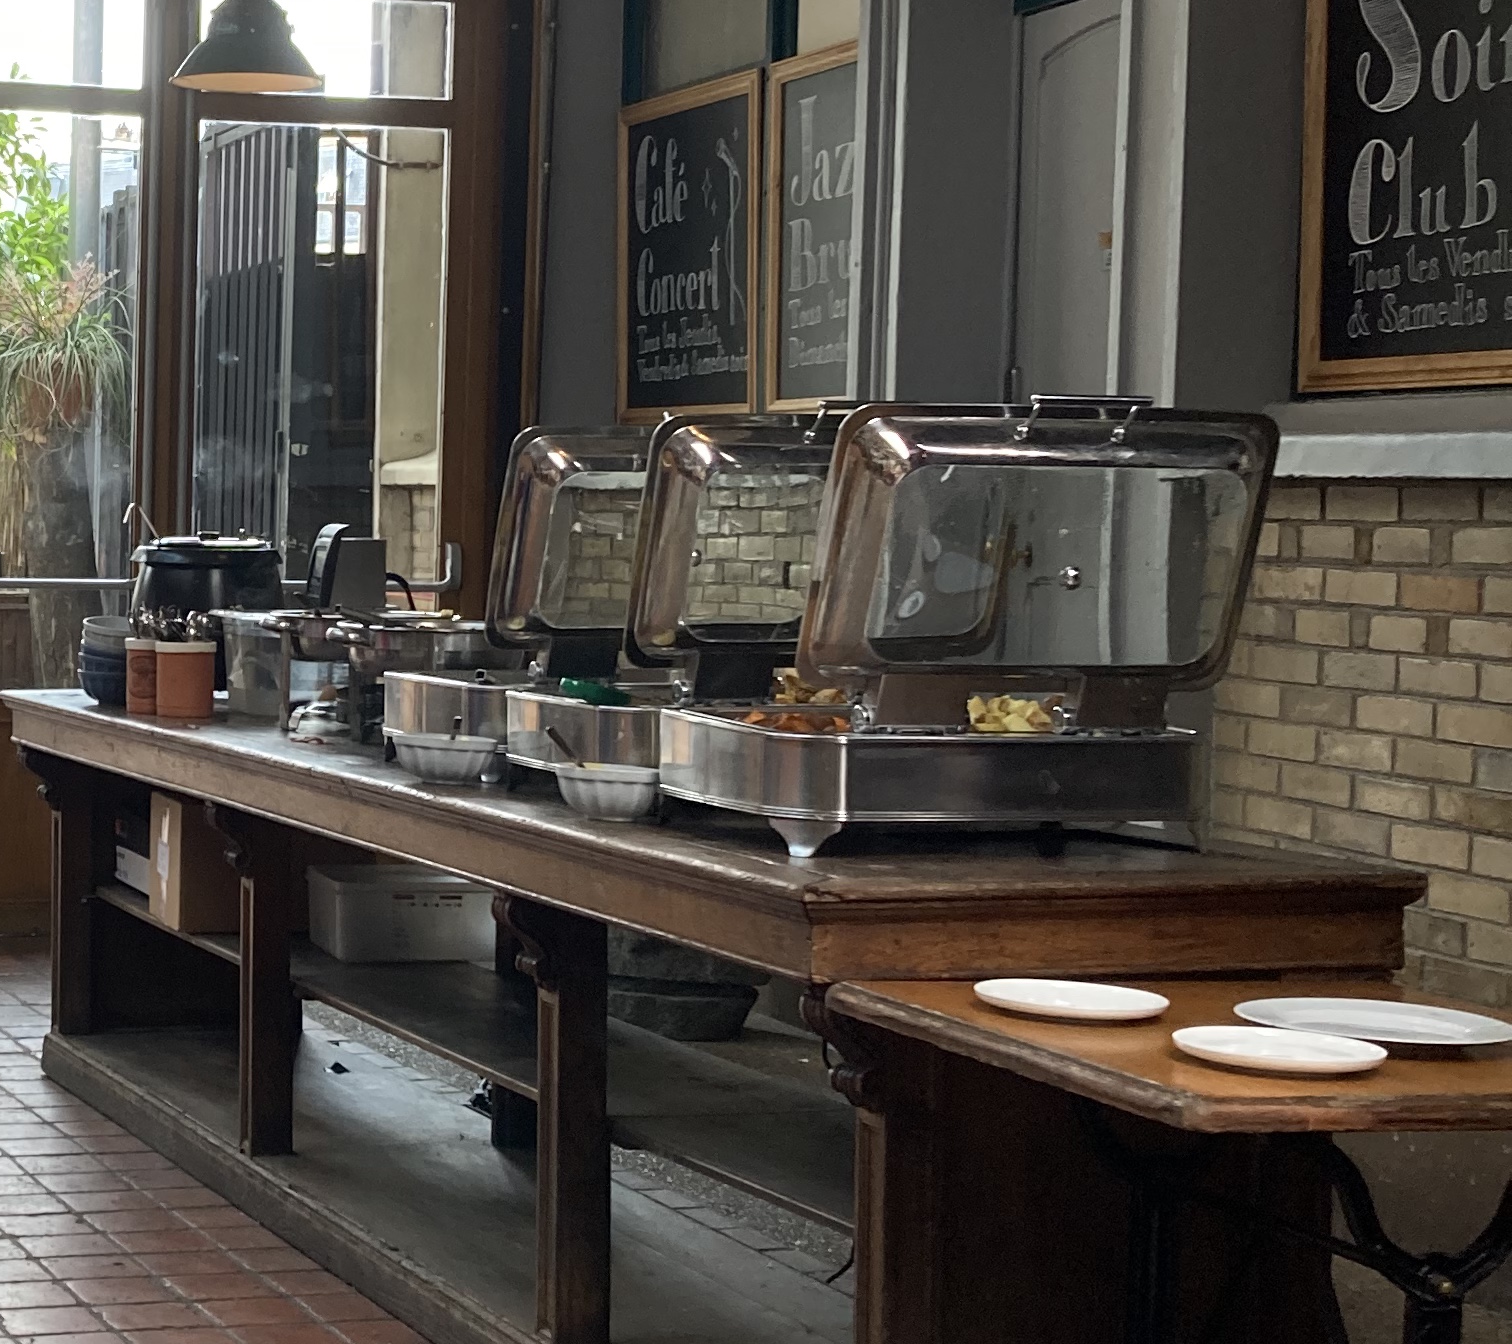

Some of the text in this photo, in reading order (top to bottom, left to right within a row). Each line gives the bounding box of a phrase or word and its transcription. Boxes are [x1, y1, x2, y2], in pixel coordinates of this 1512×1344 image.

[635, 135, 688, 235] Café
[1347, 120, 1497, 245] Club
[637, 236, 721, 317] Concert
[1348, 228, 1512, 293] Tous les Vend
[1347, 298, 1371, 339] &
[1377, 283, 1488, 334] Samedis
